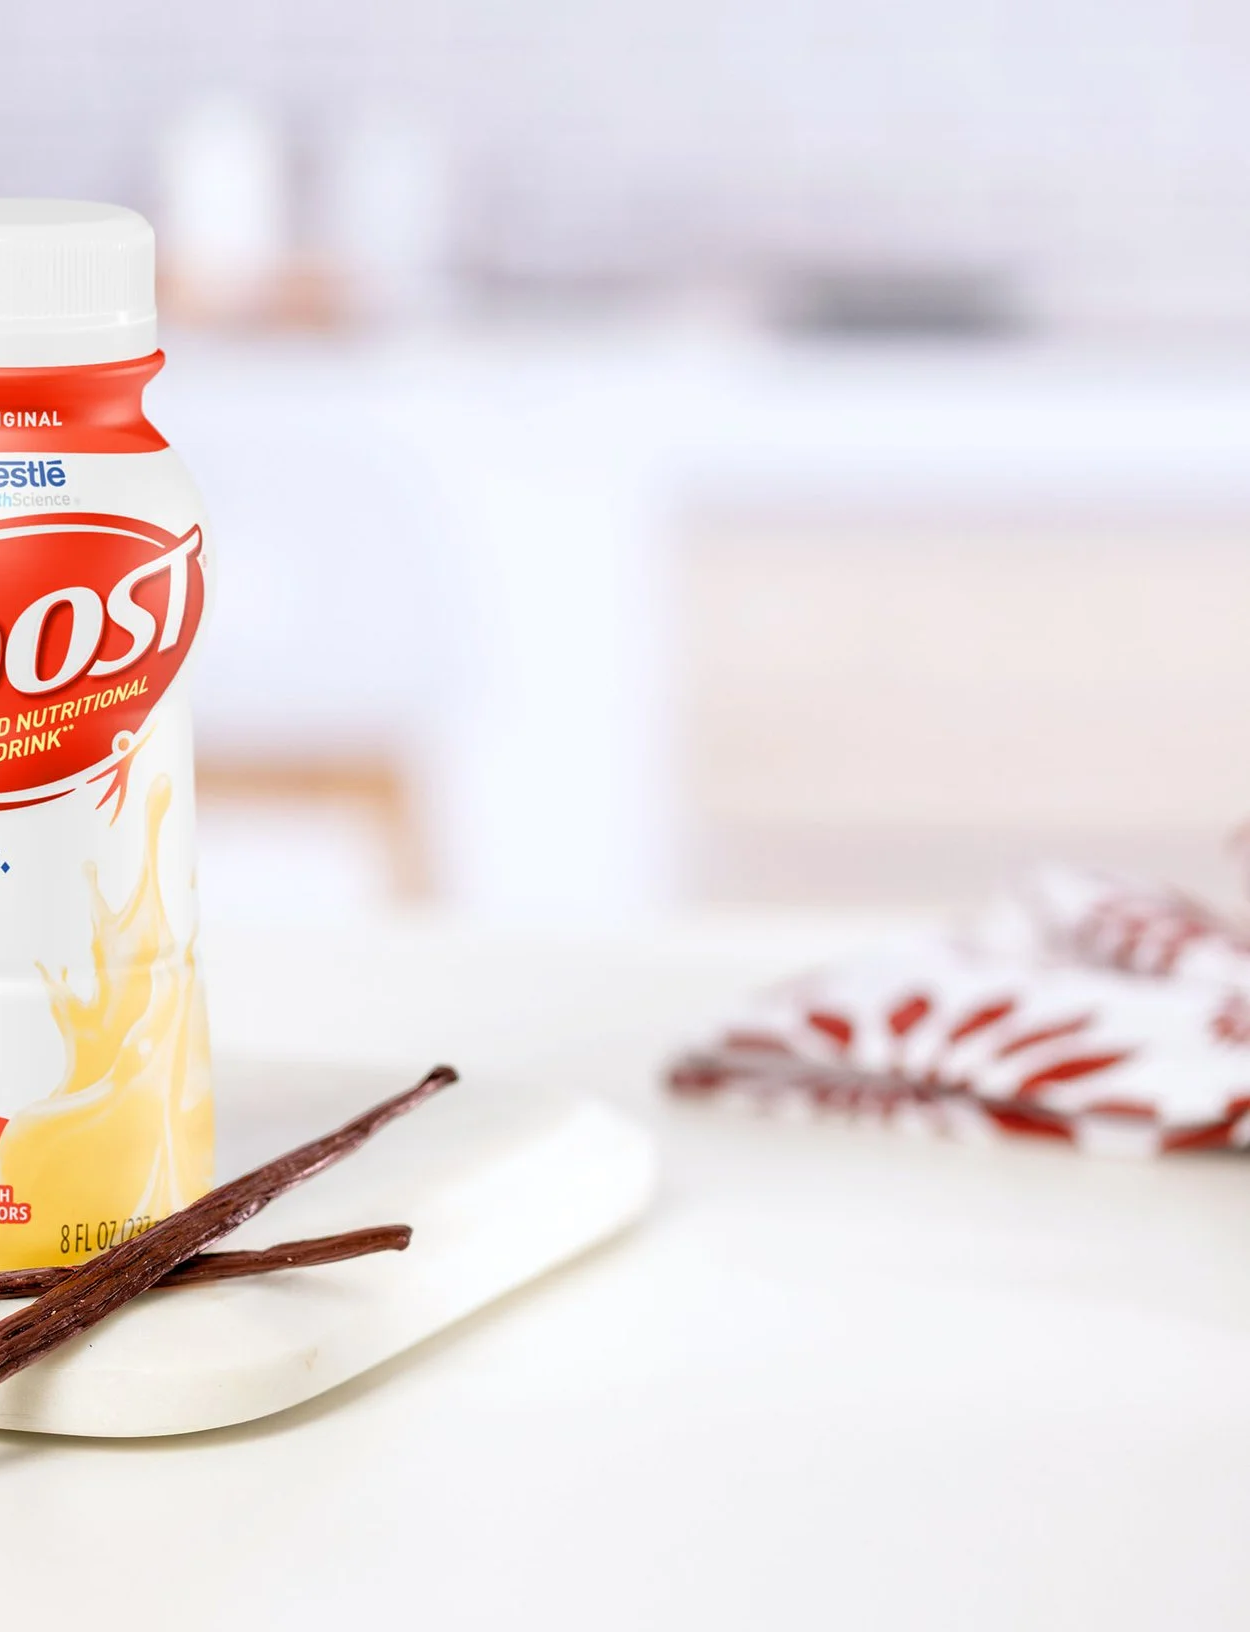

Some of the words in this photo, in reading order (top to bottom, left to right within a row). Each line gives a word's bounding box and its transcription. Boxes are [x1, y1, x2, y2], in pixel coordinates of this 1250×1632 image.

[15, 676, 149, 734] NUTRITIONAL
[60, 1224, 70, 1254] 8
[75, 1223, 92, 1252] FL
[97, 1221, 117, 1250] OZ
